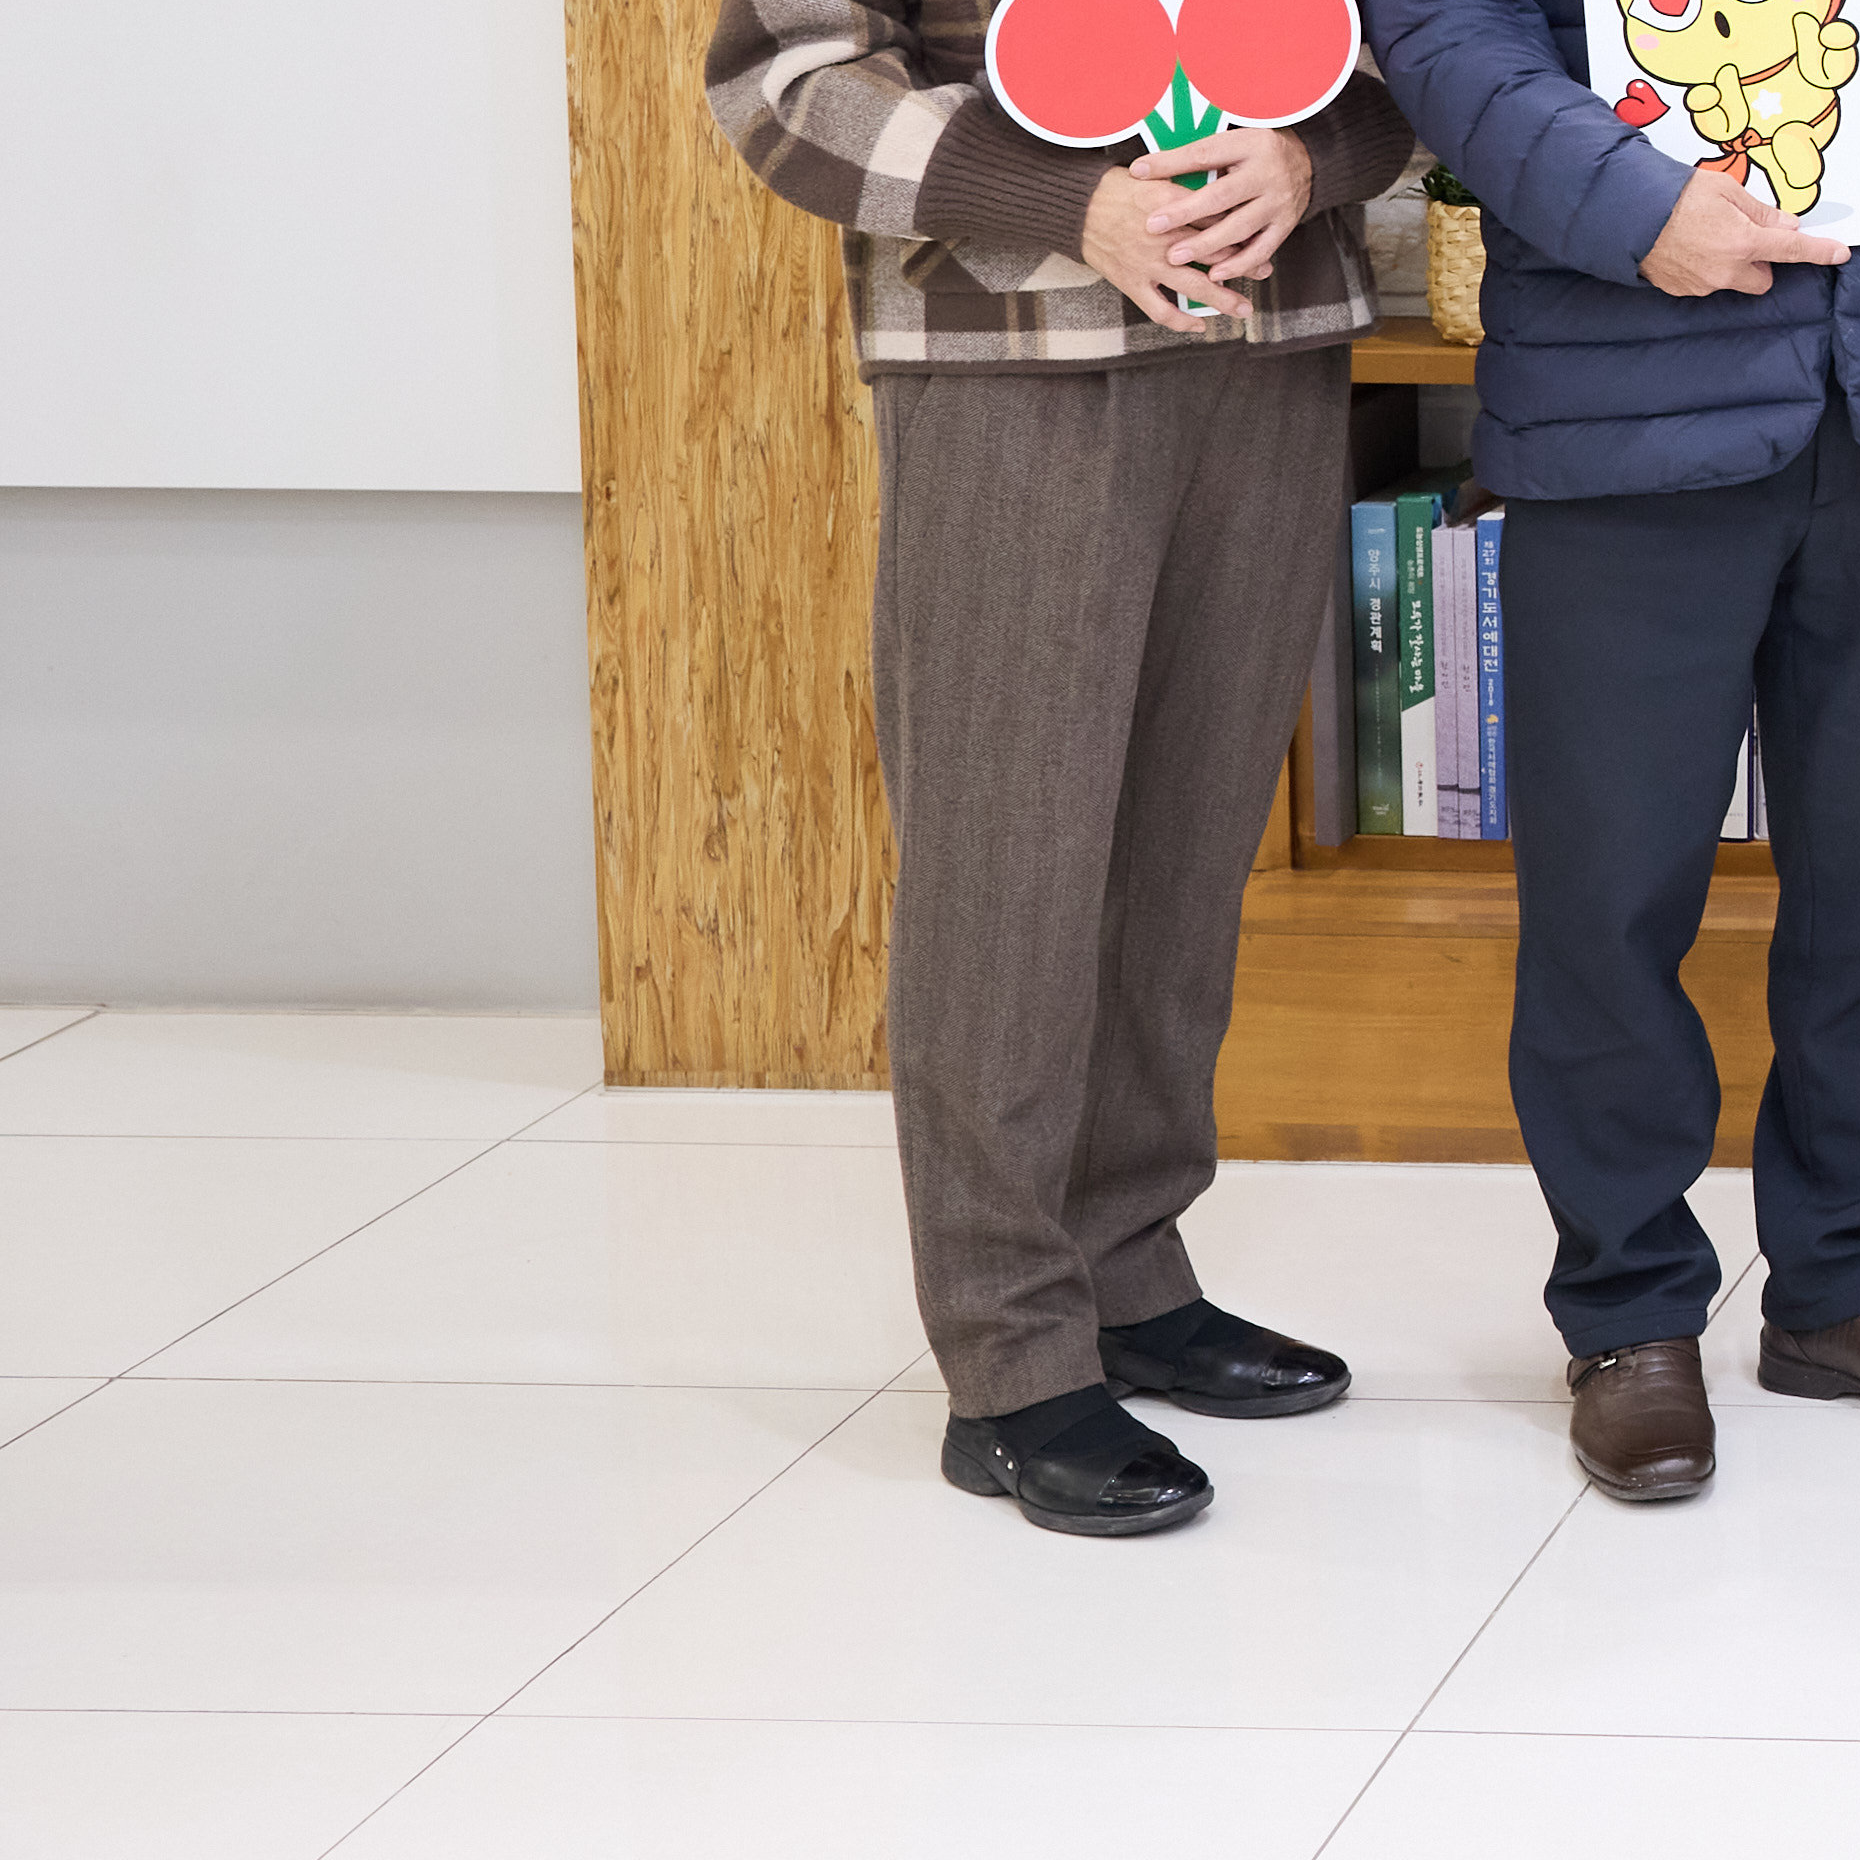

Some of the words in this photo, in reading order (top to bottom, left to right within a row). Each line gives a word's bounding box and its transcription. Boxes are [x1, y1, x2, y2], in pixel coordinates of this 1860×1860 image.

[1367, 547, 1382, 591] 양주시
[1368, 597, 1383, 653] 경관계획
[1409, 599, 1422, 631] 모두가
[1481, 570, 1500, 673] 경기도서예대전
[1409, 633, 1424, 668] 잘사는
[1409, 669, 1424, 694] 마을
